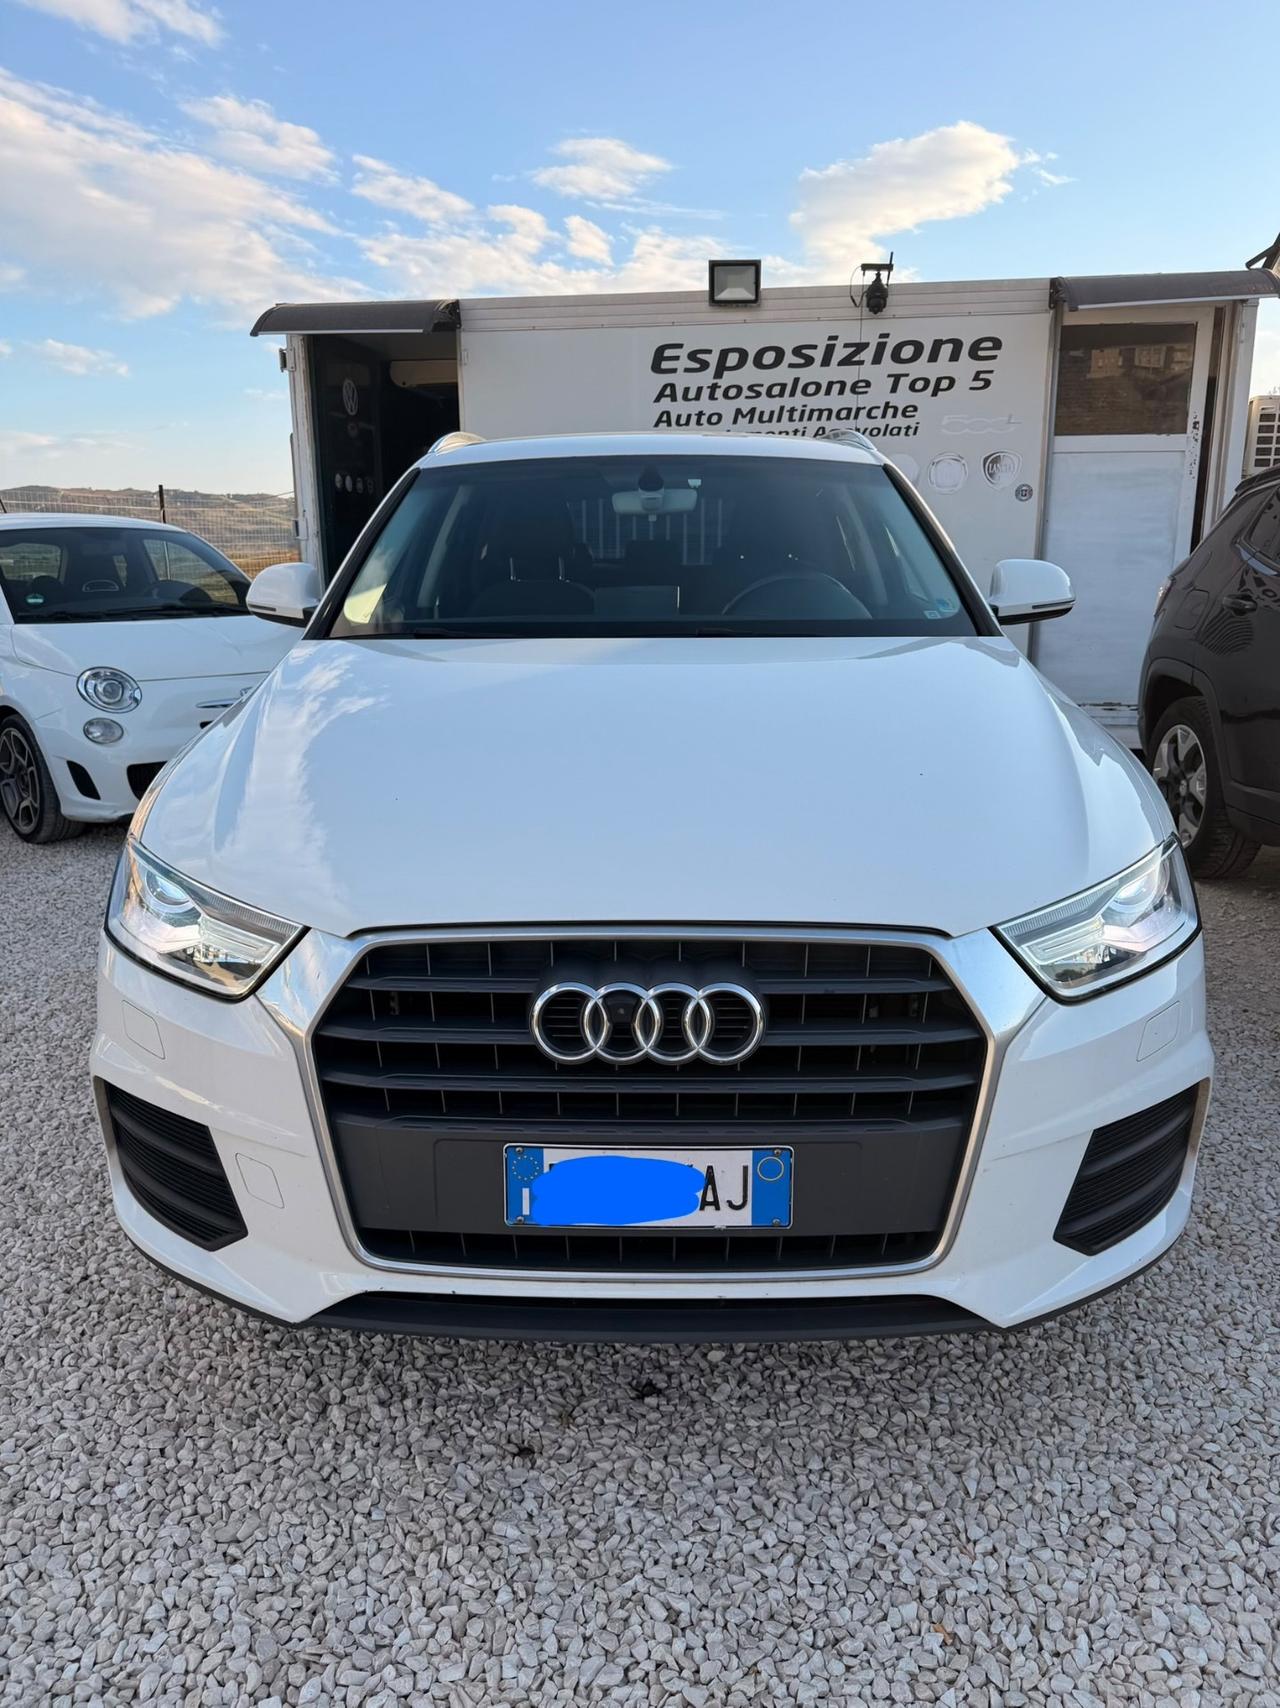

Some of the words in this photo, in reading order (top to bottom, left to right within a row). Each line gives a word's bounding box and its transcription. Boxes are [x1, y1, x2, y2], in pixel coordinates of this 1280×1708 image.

[650, 332, 1003, 380] Esposizione
[653, 376, 872, 404] Autosalone
[886, 372, 956, 398] Top
[968, 369, 995, 392] 5
[653, 409, 723, 428] Auto
[732, 400, 919, 426] Multimarche
[813, 421, 921, 438] Avolati
